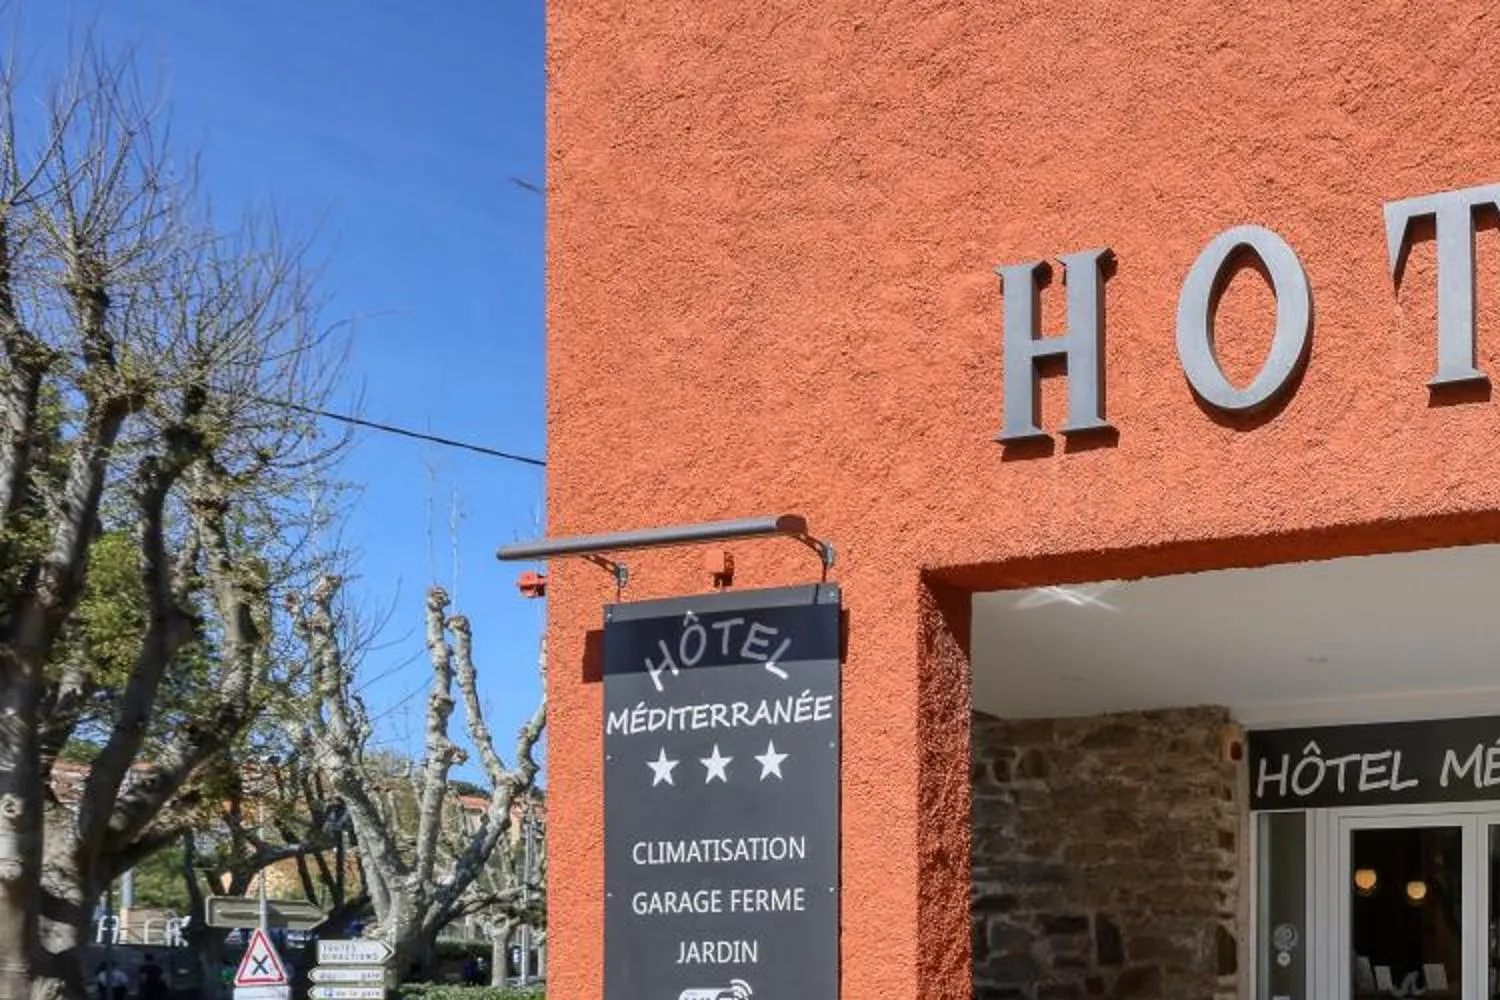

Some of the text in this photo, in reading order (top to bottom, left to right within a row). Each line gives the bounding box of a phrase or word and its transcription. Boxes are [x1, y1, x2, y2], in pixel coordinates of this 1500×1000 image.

[644, 609, 792, 692] HÔTEL
[606, 689, 834, 736] MÉDITERRANÉE
[1256, 739, 1419, 798] HÔTEL
[632, 836, 806, 865] CLIMATISATION
[632, 888, 806, 915] GARAGE FERME
[676, 941, 758, 964] JARDIN
